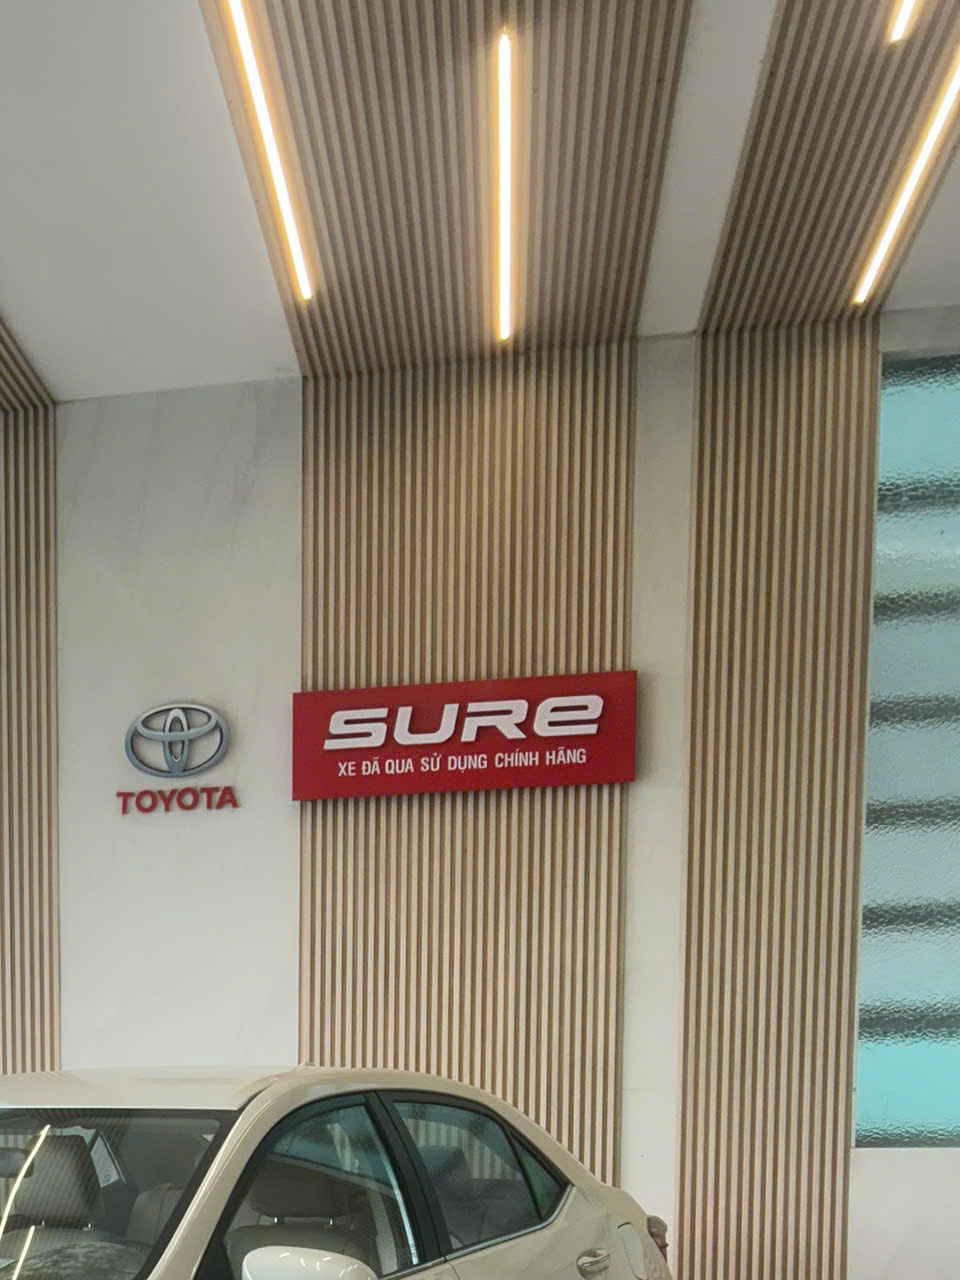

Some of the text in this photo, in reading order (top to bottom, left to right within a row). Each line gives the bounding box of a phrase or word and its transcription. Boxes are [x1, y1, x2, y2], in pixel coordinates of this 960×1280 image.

[338, 747, 587, 776] XE ĐÃ QUA SỬ DỤNG CHÍNH HÃNG
[116, 786, 238, 816] TOYOTA
